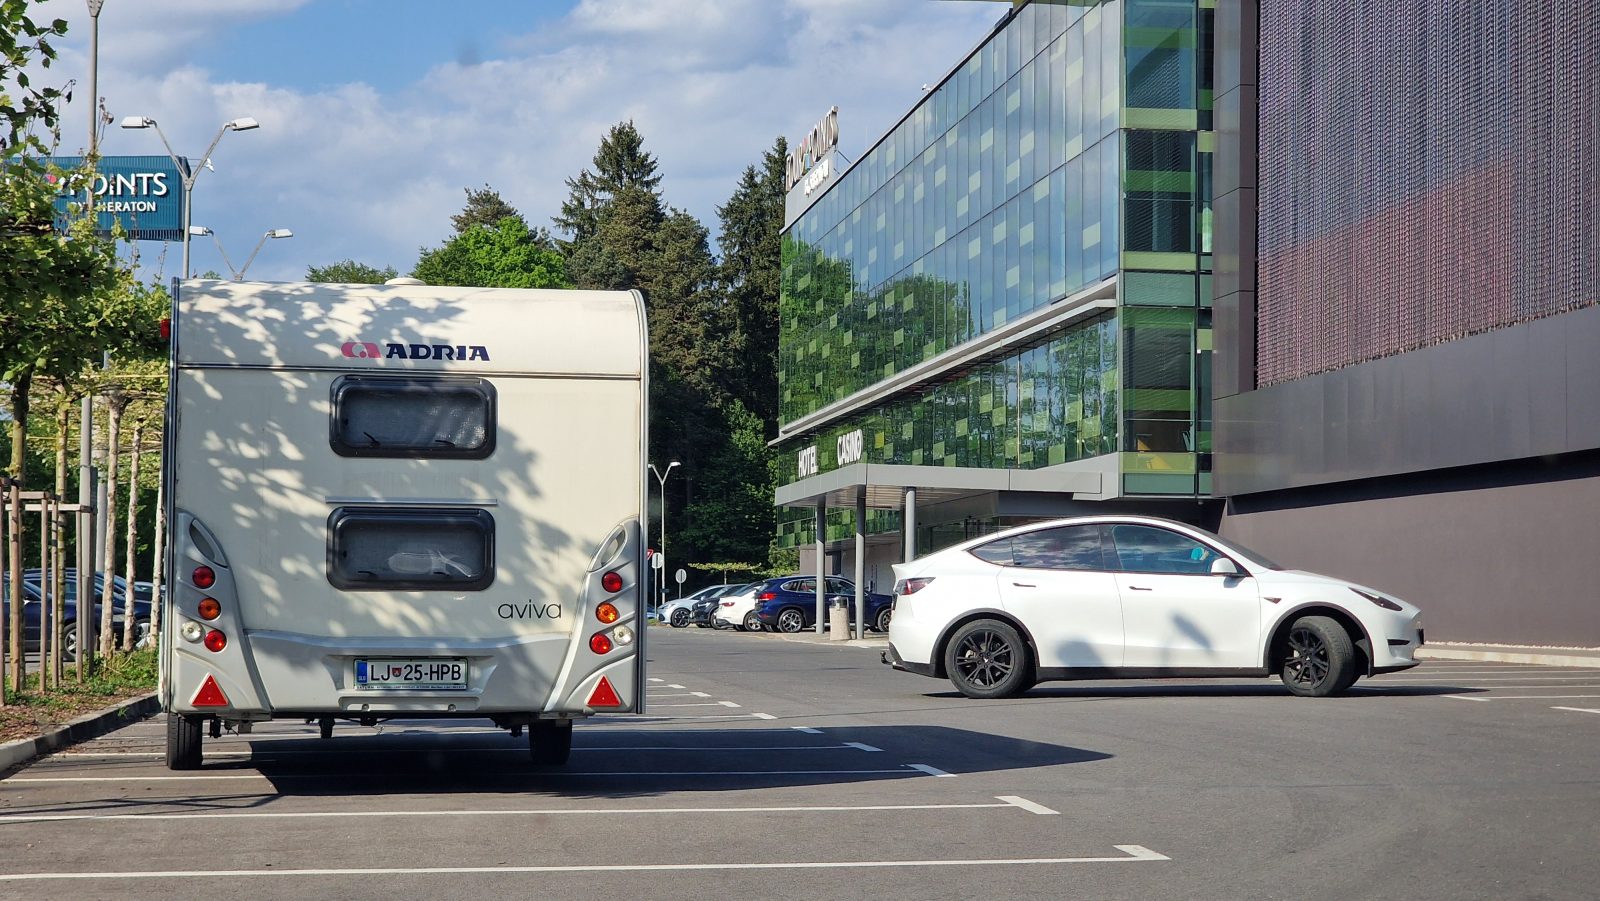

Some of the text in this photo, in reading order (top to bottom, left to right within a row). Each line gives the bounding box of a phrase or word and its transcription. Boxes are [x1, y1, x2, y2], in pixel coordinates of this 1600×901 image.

[95, 201, 157, 212] HERATON
[386, 343, 490, 361] ADRIA
[837, 428, 863, 466] CASINO
[798, 445, 818, 478] HOTEL
[497, 599, 562, 619] aviva
[370, 664, 461, 681] LJ 25-HPB
